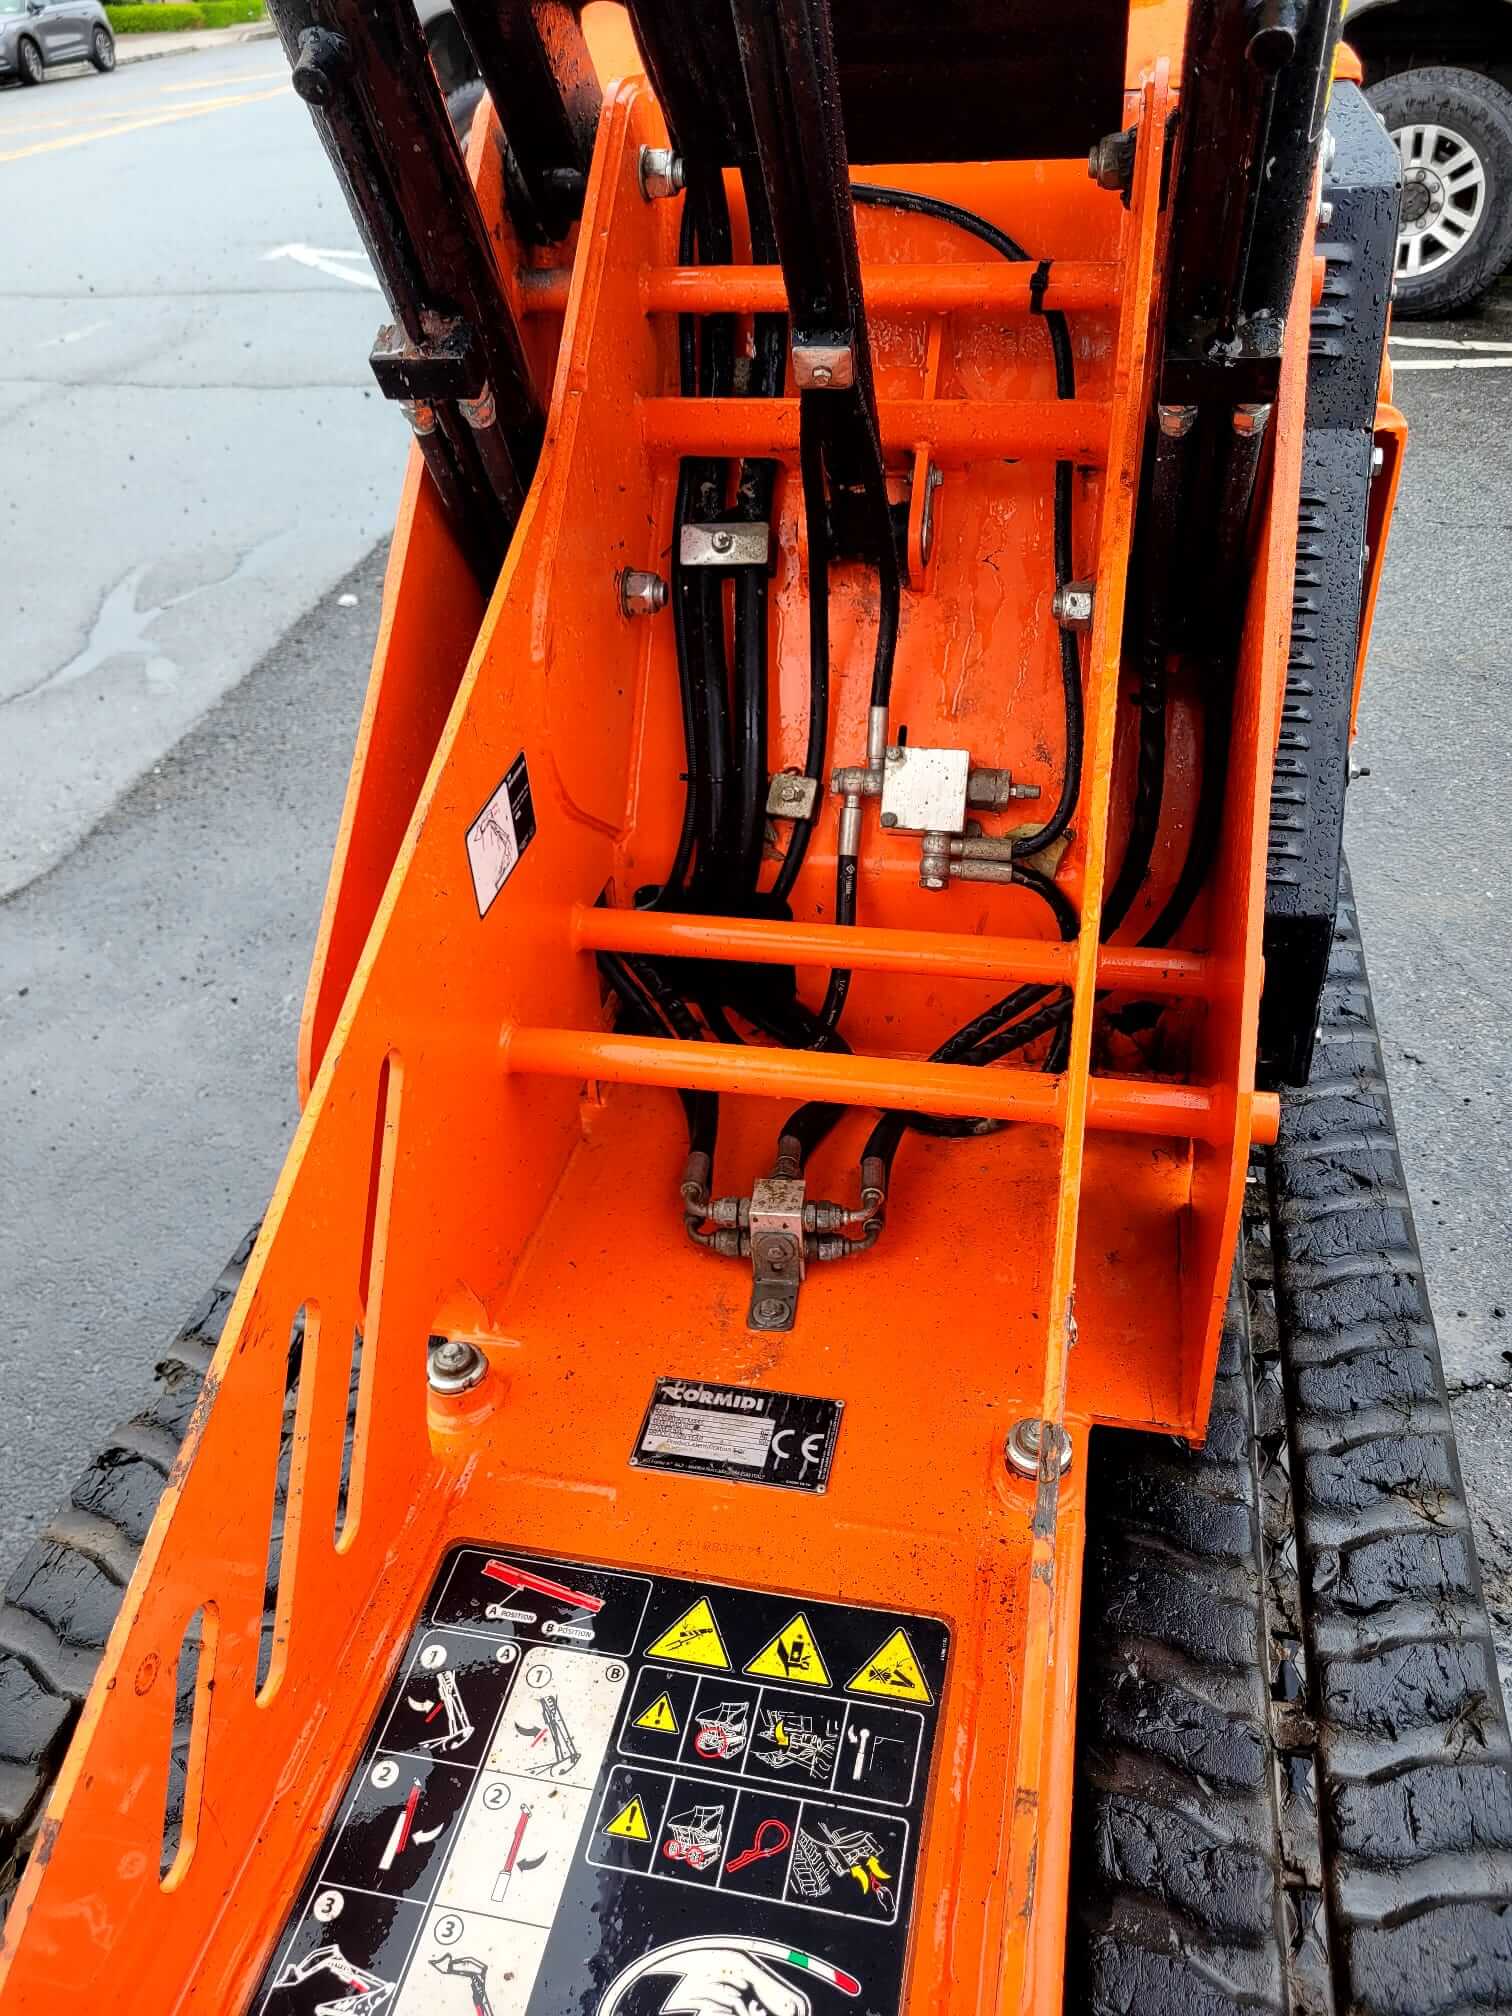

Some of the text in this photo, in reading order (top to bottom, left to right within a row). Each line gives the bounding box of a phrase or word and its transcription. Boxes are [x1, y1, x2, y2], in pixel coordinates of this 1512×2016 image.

[488, 1606, 535, 1622] A POSITION
[545, 1623, 593, 1638] B POSITION
[428, 1649, 439, 1665] 1
[500, 1647, 513, 1663] A
[533, 1668, 544, 1686] 1
[609, 1665, 621, 1682] B
[378, 1764, 392, 1784] 2
[489, 1787, 504, 1805] 2
[320, 1897, 335, 1914] 3
[441, 1921, 456, 1939] 3
